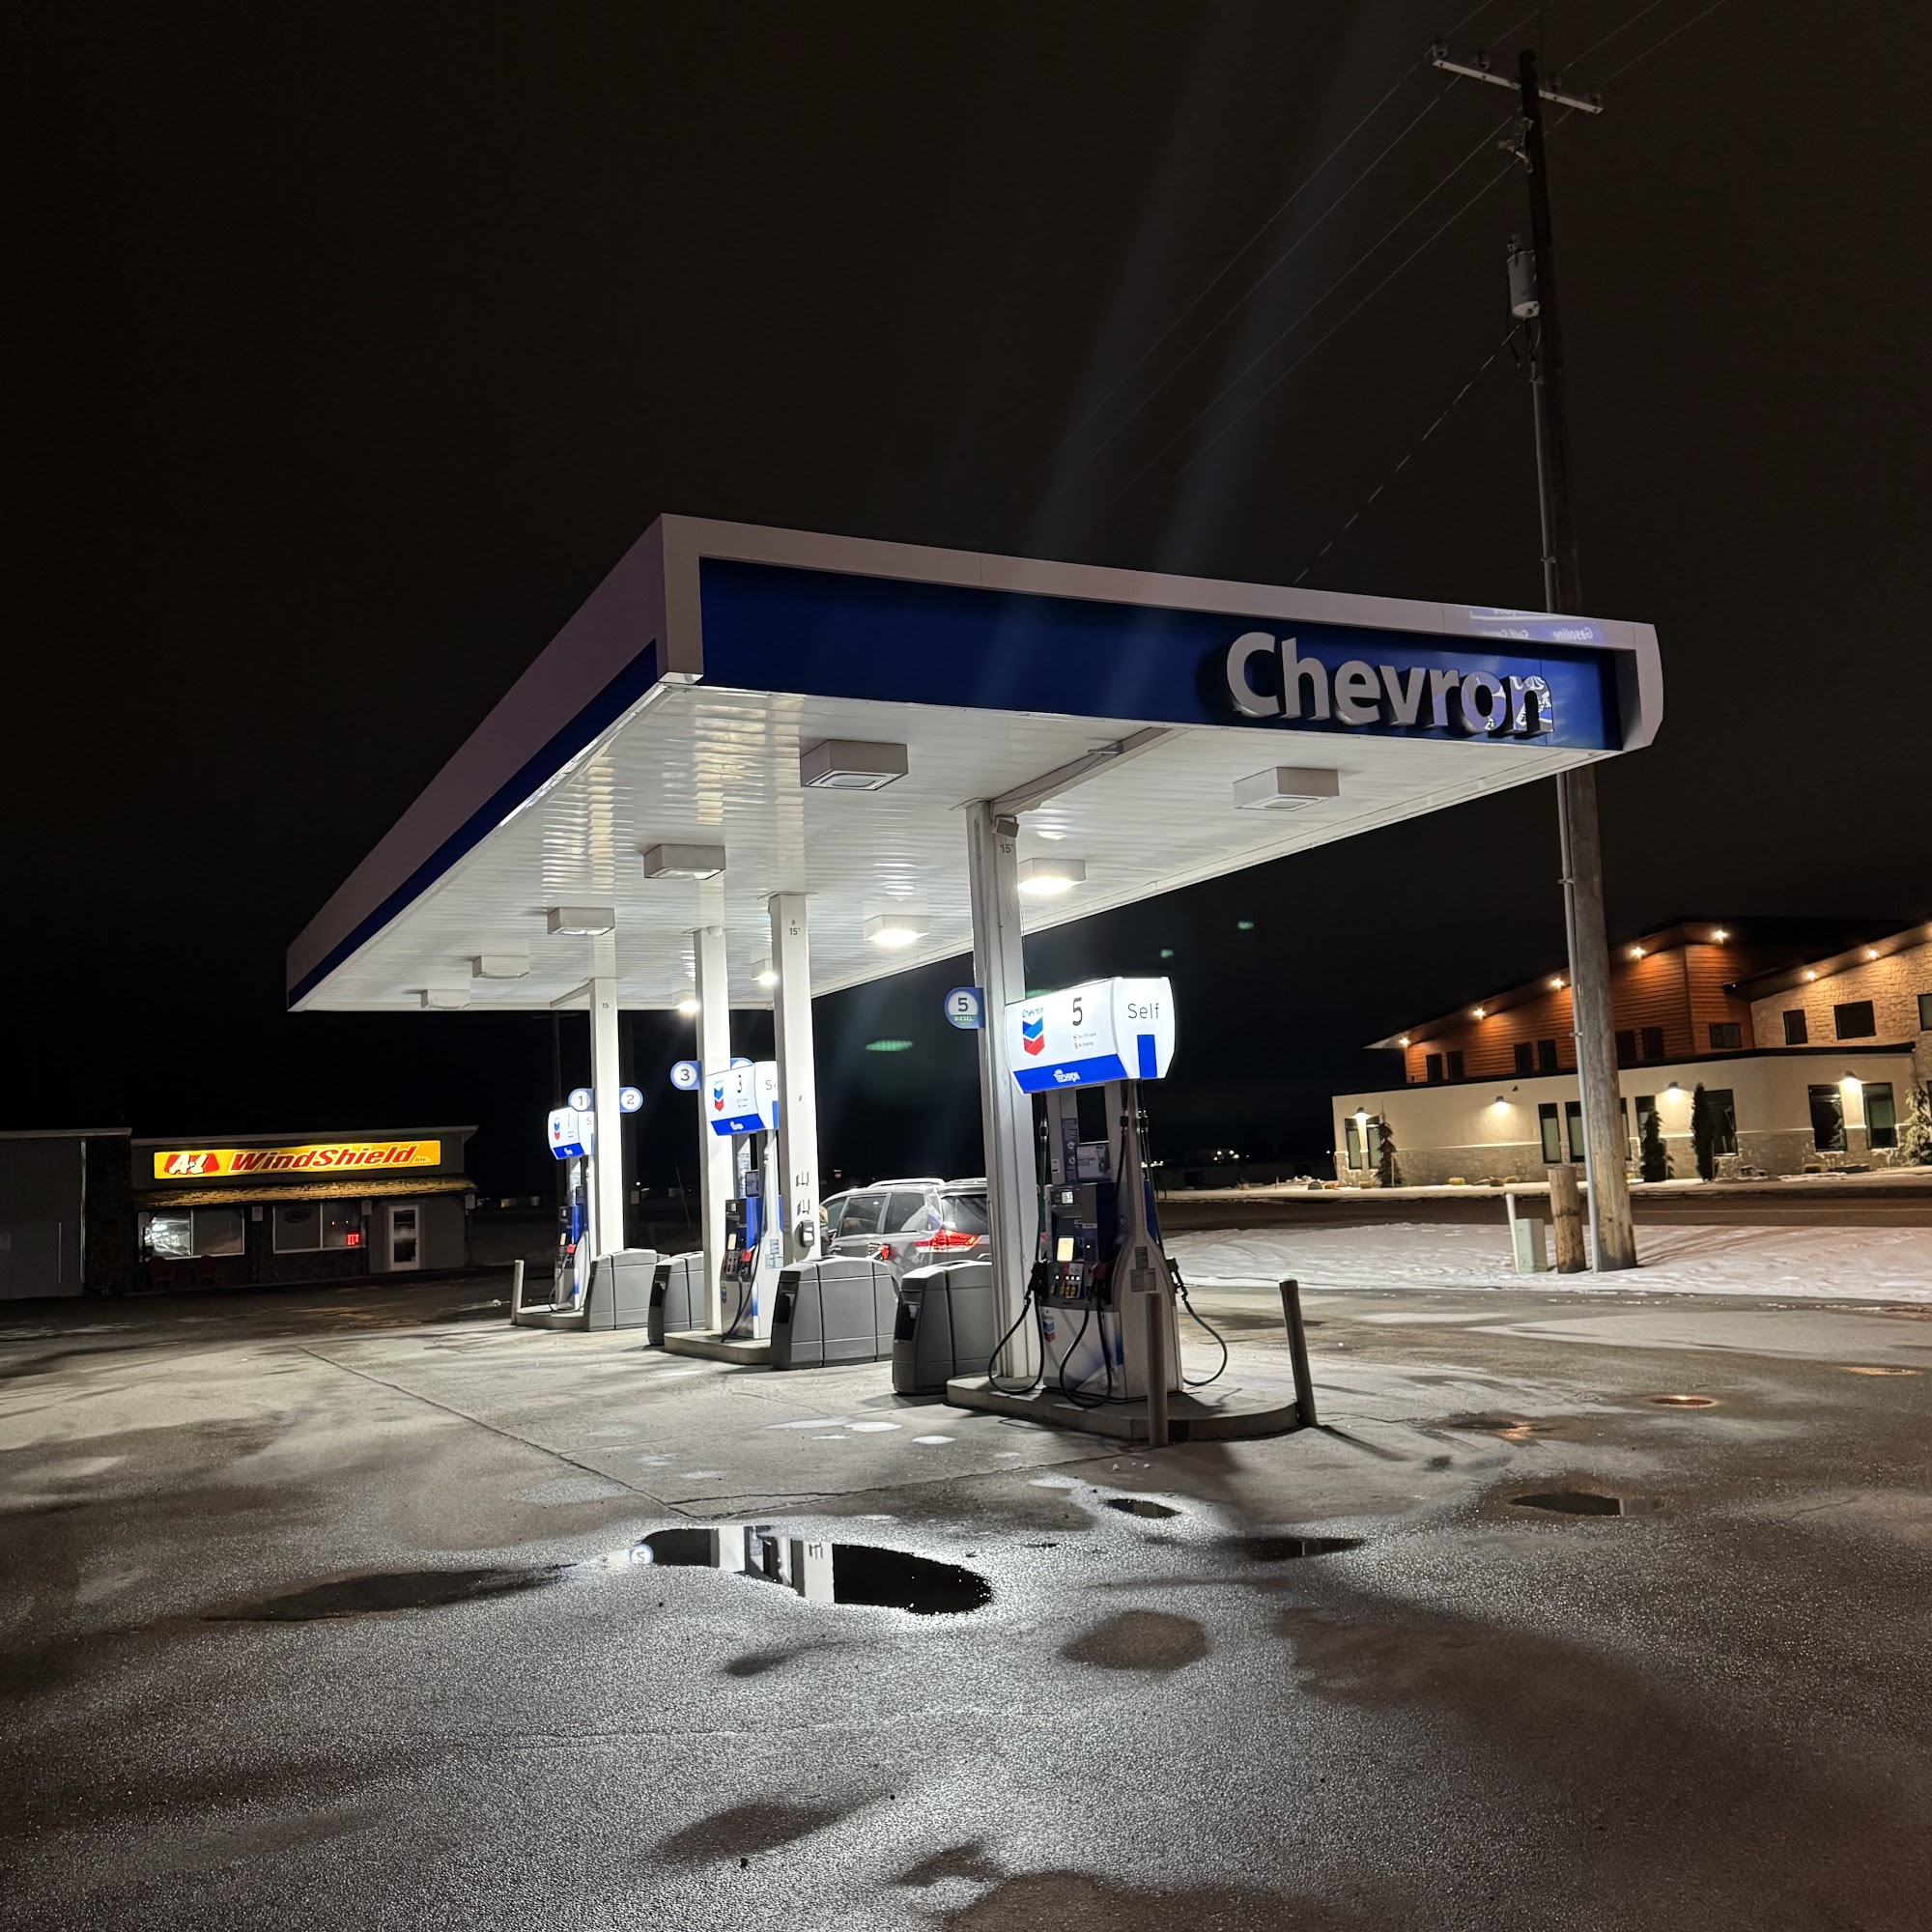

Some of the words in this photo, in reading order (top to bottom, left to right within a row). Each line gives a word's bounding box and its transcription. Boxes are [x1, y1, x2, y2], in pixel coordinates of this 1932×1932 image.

[1227, 631, 1554, 732] Chevron
[957, 997, 969, 1012] 5
[1072, 996, 1083, 1027] 5
[1127, 1003, 1160, 1019] Self
[680, 1068, 691, 1082] 3
[578, 1094, 583, 1106] 1
[626, 1094, 635, 1105] 2
[229, 1145, 418, 1172] WindShield
